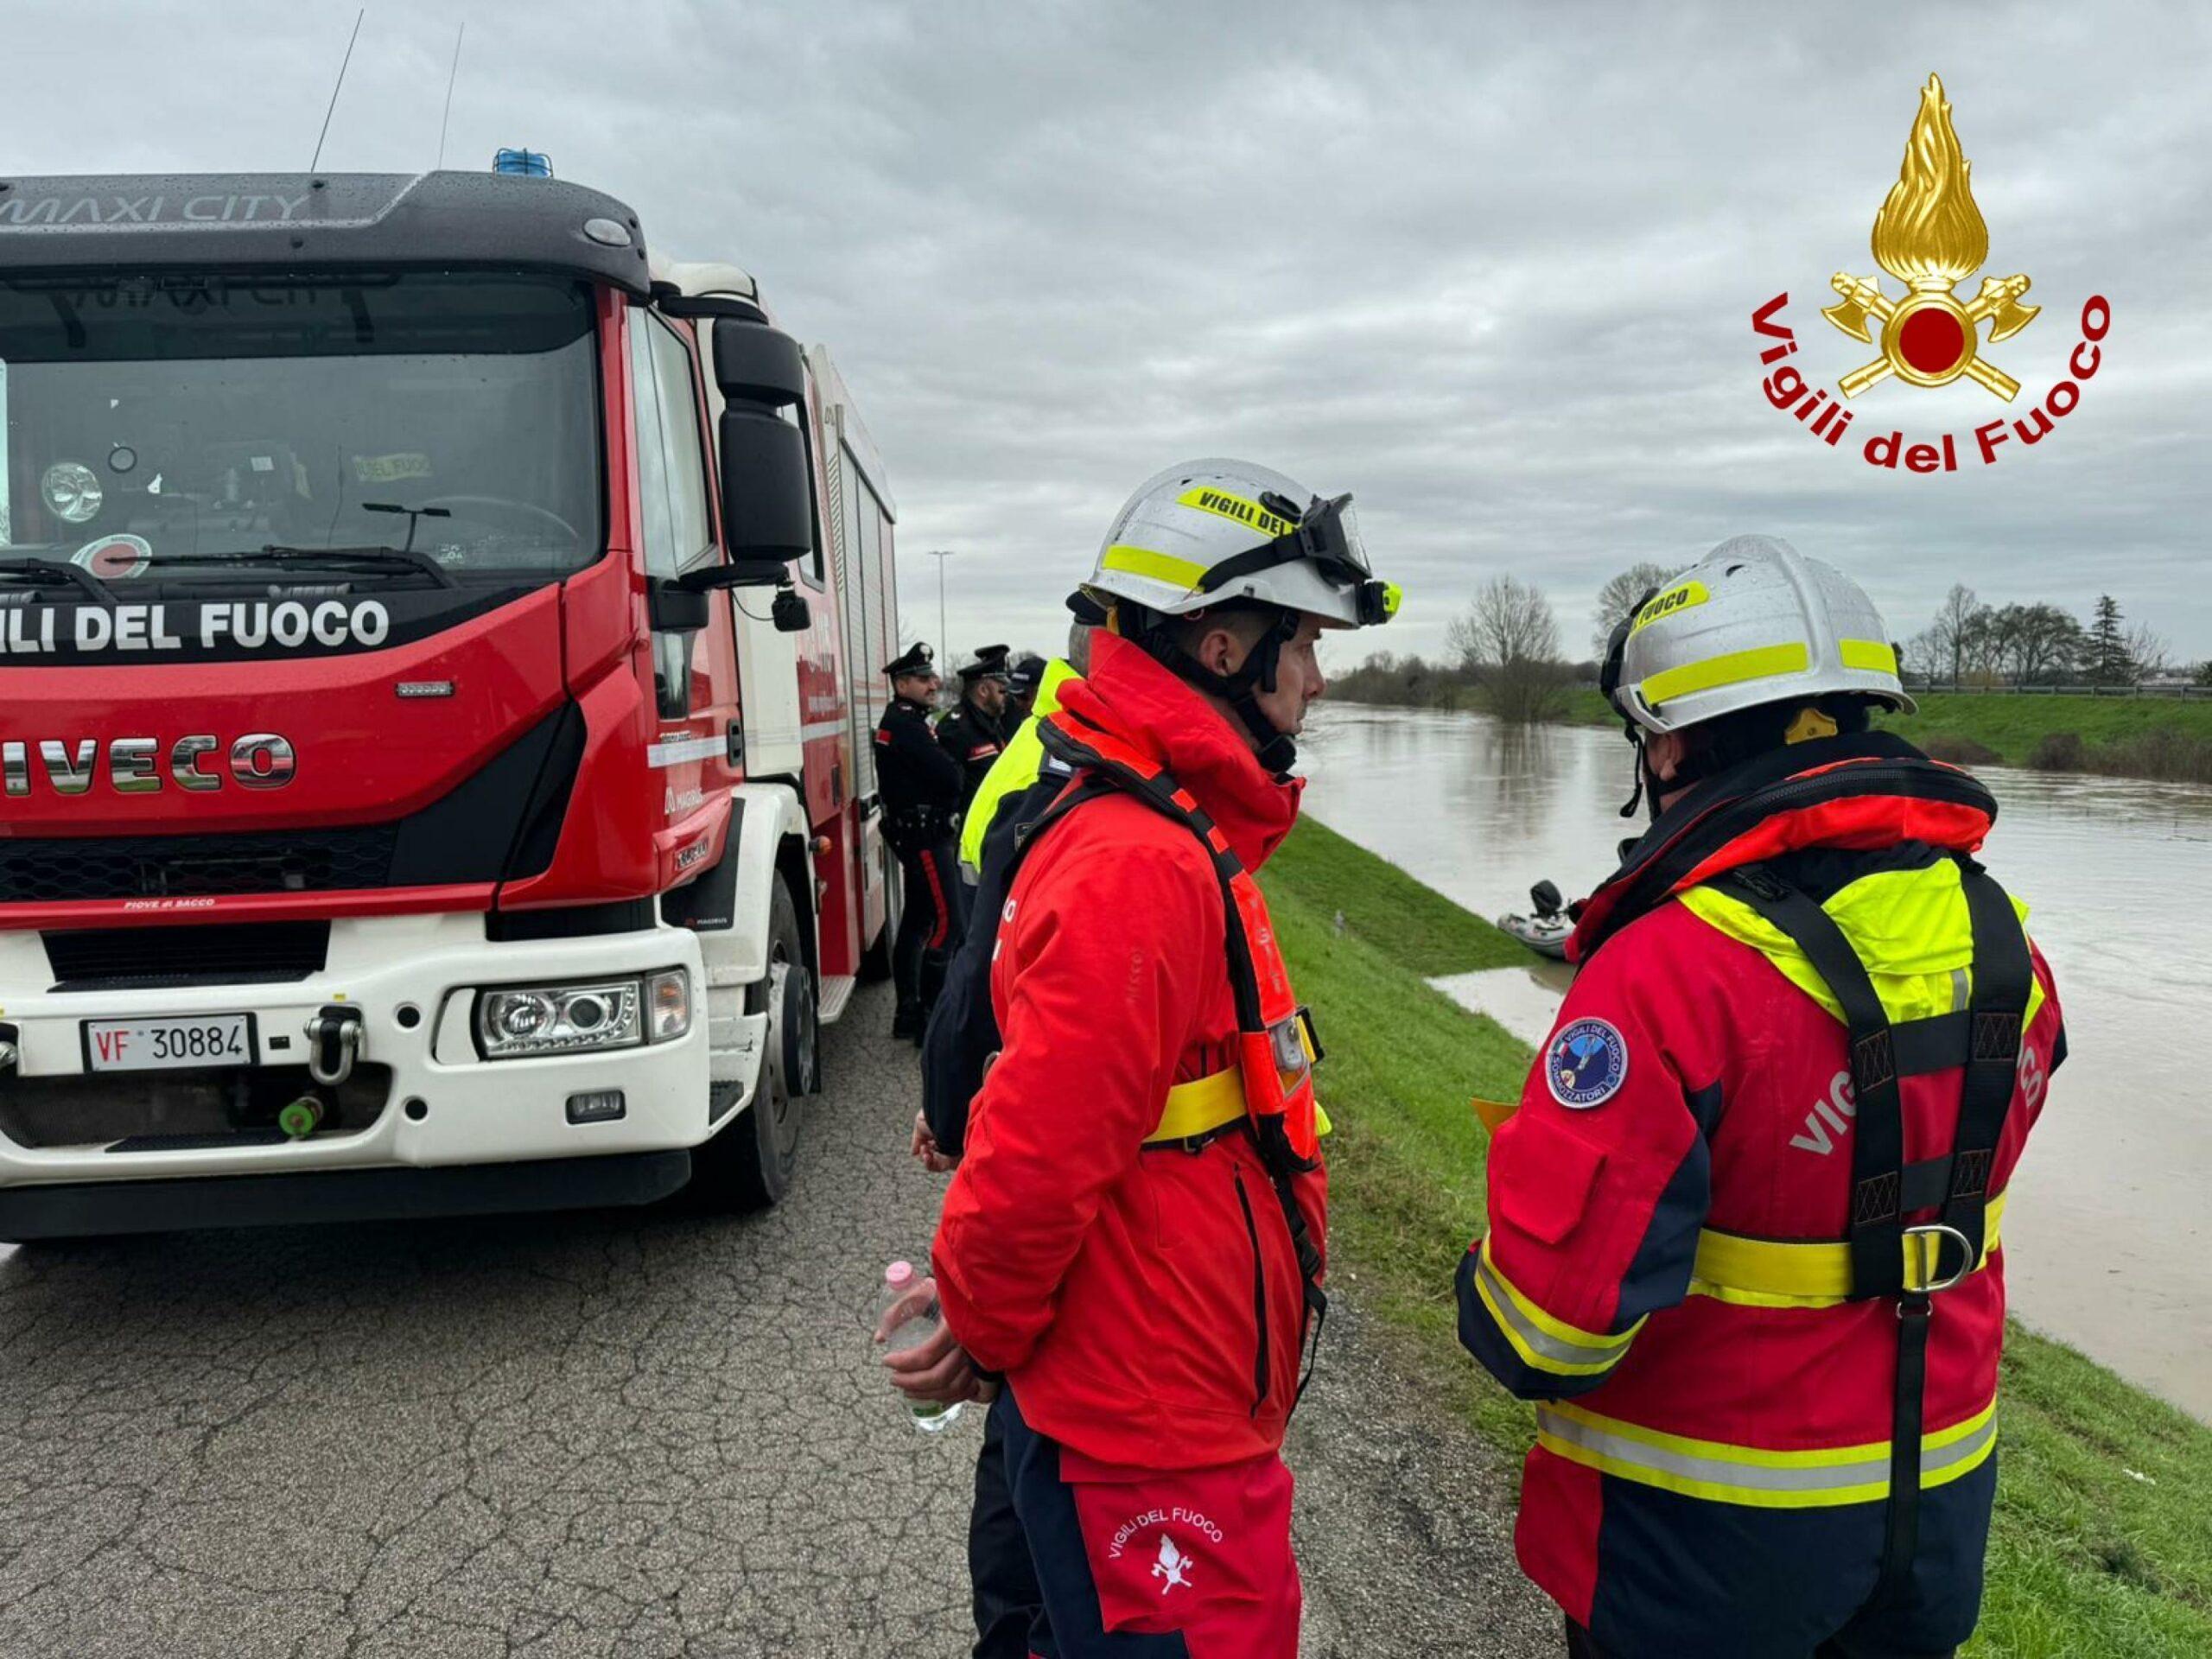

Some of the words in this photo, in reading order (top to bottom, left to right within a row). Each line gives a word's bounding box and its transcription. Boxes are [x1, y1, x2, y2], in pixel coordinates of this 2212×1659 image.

[183, 194, 311, 220] CITY
[1199, 491, 1255, 522] VIGILI
[75, 604, 181, 651] DEL
[200, 601, 389, 647] FUOCO
[3, 734, 297, 796] IVECO
[96, 1030, 128, 1061] VF
[150, 1025, 243, 1058] 30884
[1591, 1025, 1607, 1037] DEL
[1607, 1035, 1620, 1072] FUOCO
[1789, 1070, 1857, 1154] VIG
[1109, 1519, 1138, 1559] VIGILI
[1136, 1509, 1169, 1528] DEL
[1172, 1507, 1223, 1543] FUOCO
